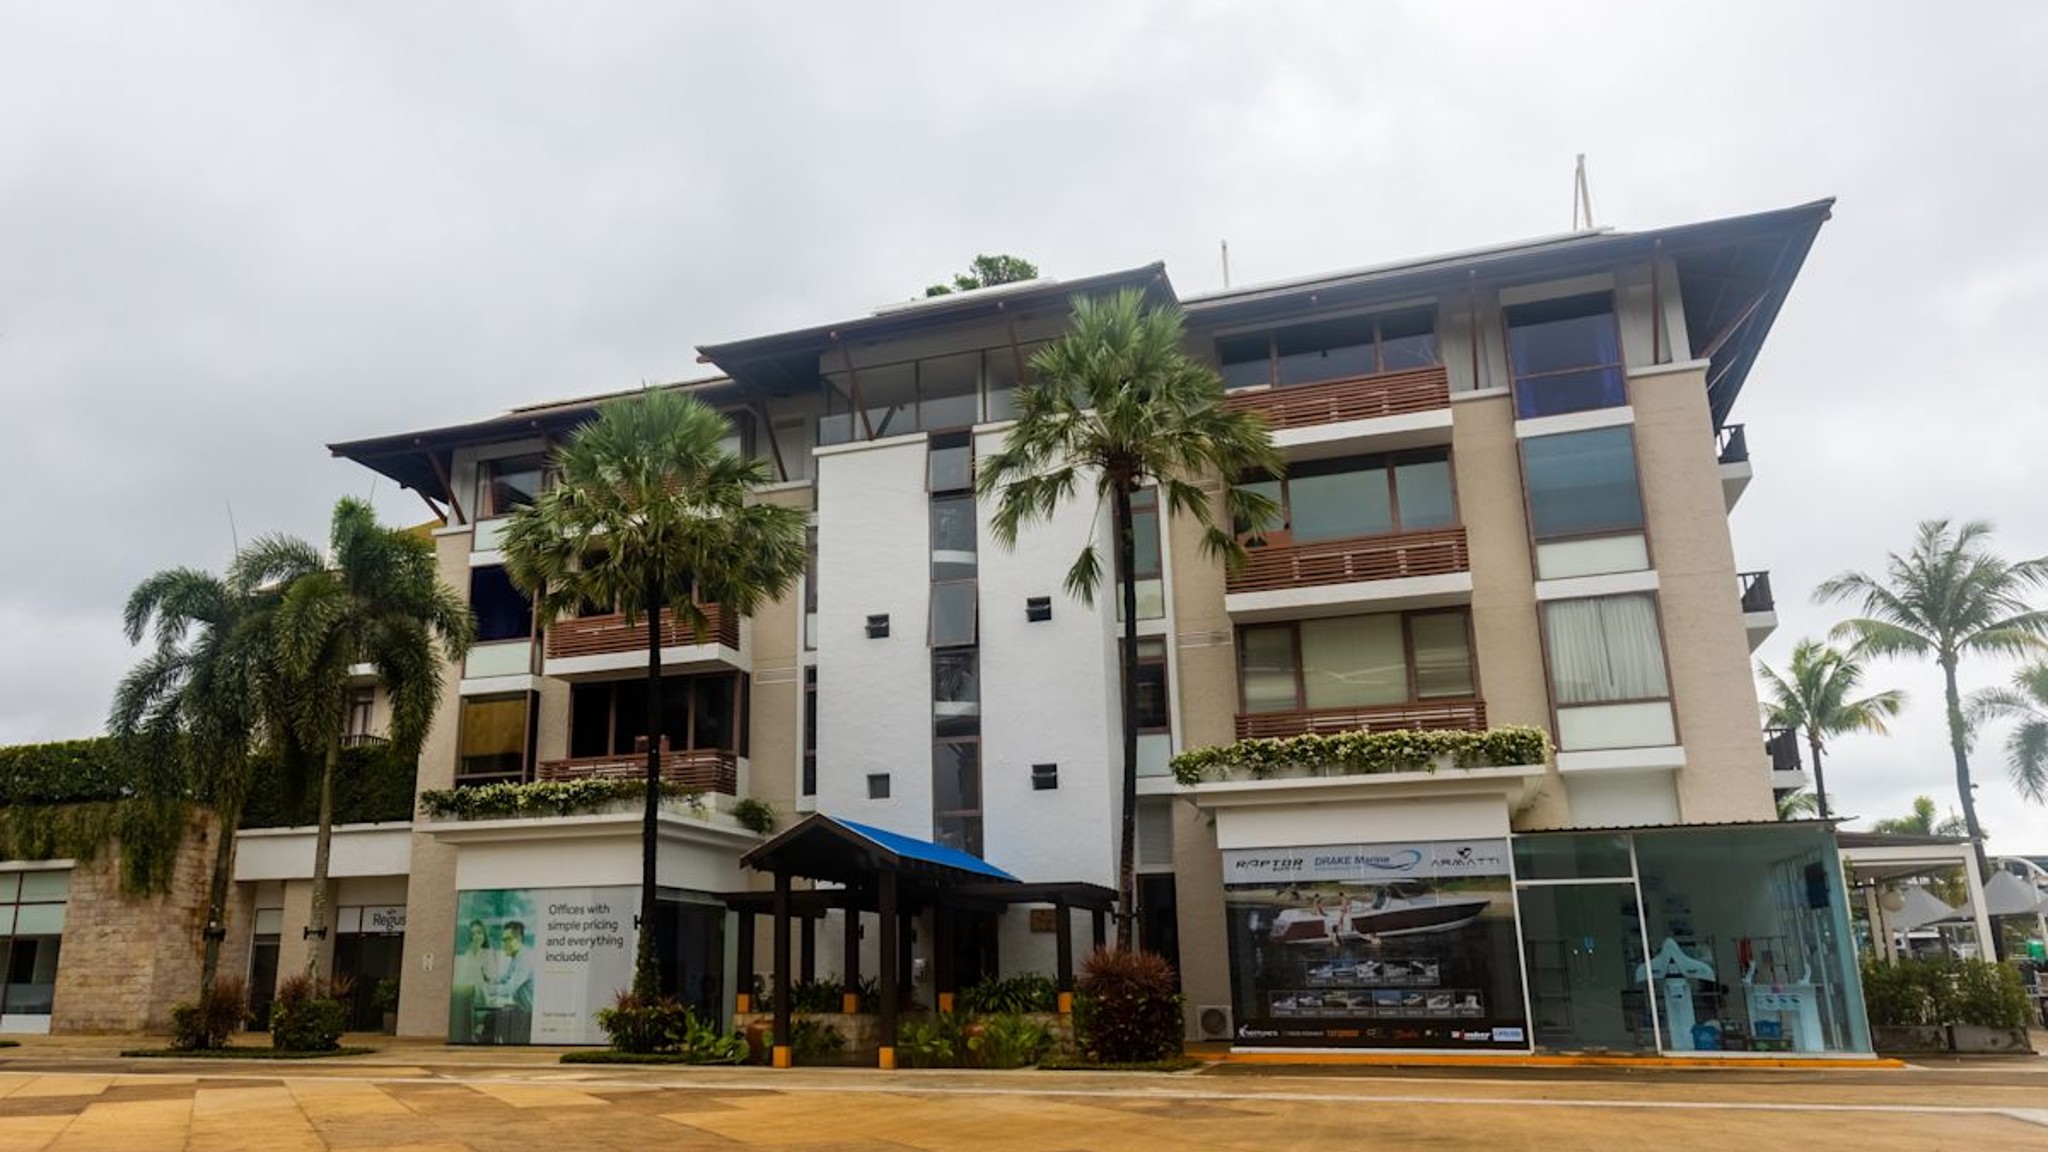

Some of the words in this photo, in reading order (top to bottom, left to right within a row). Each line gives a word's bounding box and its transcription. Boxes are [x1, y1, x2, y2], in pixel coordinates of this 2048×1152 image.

[1235, 858, 1303, 869] RAPTOR
[1314, 856, 1351, 866] DRAKE
[1354, 855, 1390, 864] Marine
[1431, 857, 1500, 867] ARMATTI
[548, 904, 584, 915] Offices
[587, 903, 610, 914] with
[373, 912, 407, 931] Regus
[547, 920, 580, 932] simple
[583, 920, 619, 932] pricing
[546, 936, 566, 946] and
[568, 935, 624, 949] everything
[545, 951, 589, 962] included
